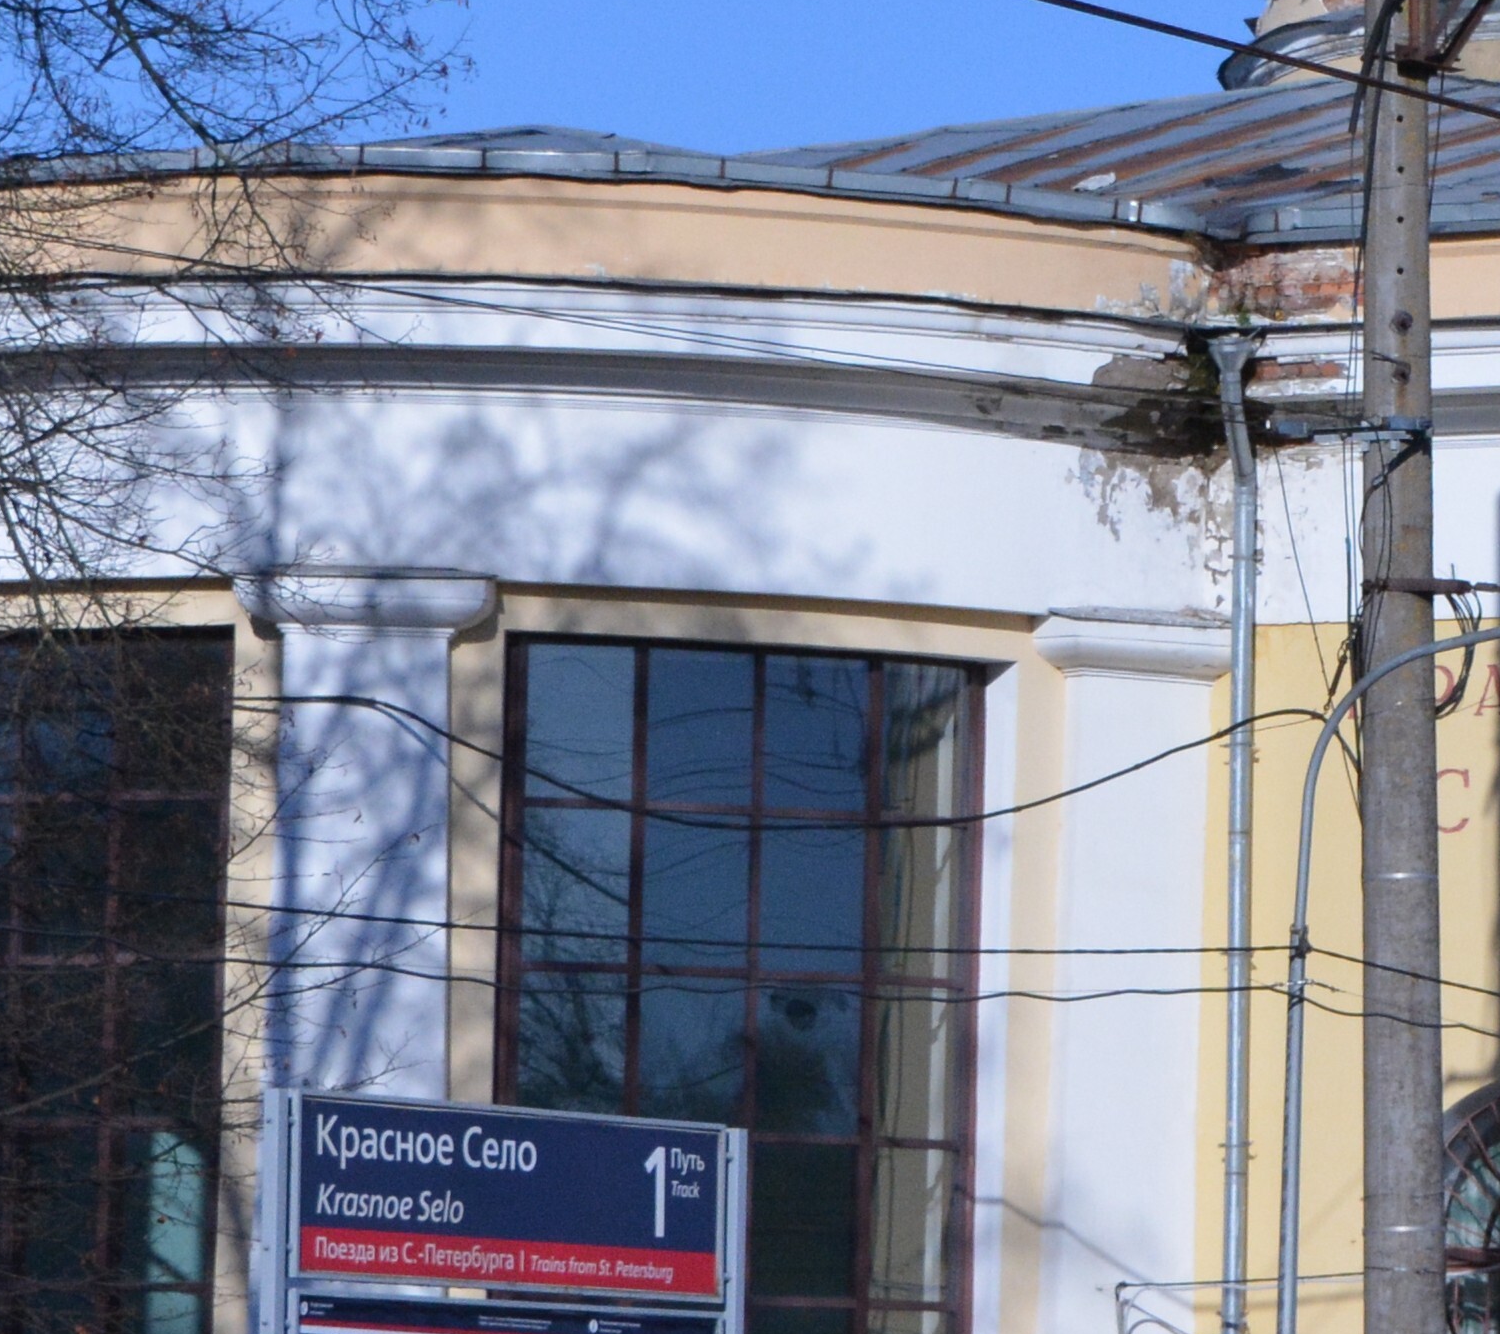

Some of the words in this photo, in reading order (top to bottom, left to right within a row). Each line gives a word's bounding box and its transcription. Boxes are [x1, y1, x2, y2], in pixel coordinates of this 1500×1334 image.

[316, 1113, 454, 1170] Красное
[462, 1125, 538, 1172] Село
[670, 1148, 705, 1176] Путь
[316, 1183, 414, 1221] Krasnoe
[417, 1189, 464, 1224] Selo
[644, 1146, 666, 1238] 1
[671, 1180, 700, 1199] Track
[315, 1236, 376, 1264] Поезда
[379, 1244, 399, 1263] из
[402, 1242, 515, 1274] С.-Петербурга
[530, 1255, 567, 1274] Trains
[568, 1256, 597, 1275] from
[598, 1259, 613, 1276] St.
[615, 1260, 674, 1284] Petersburg
